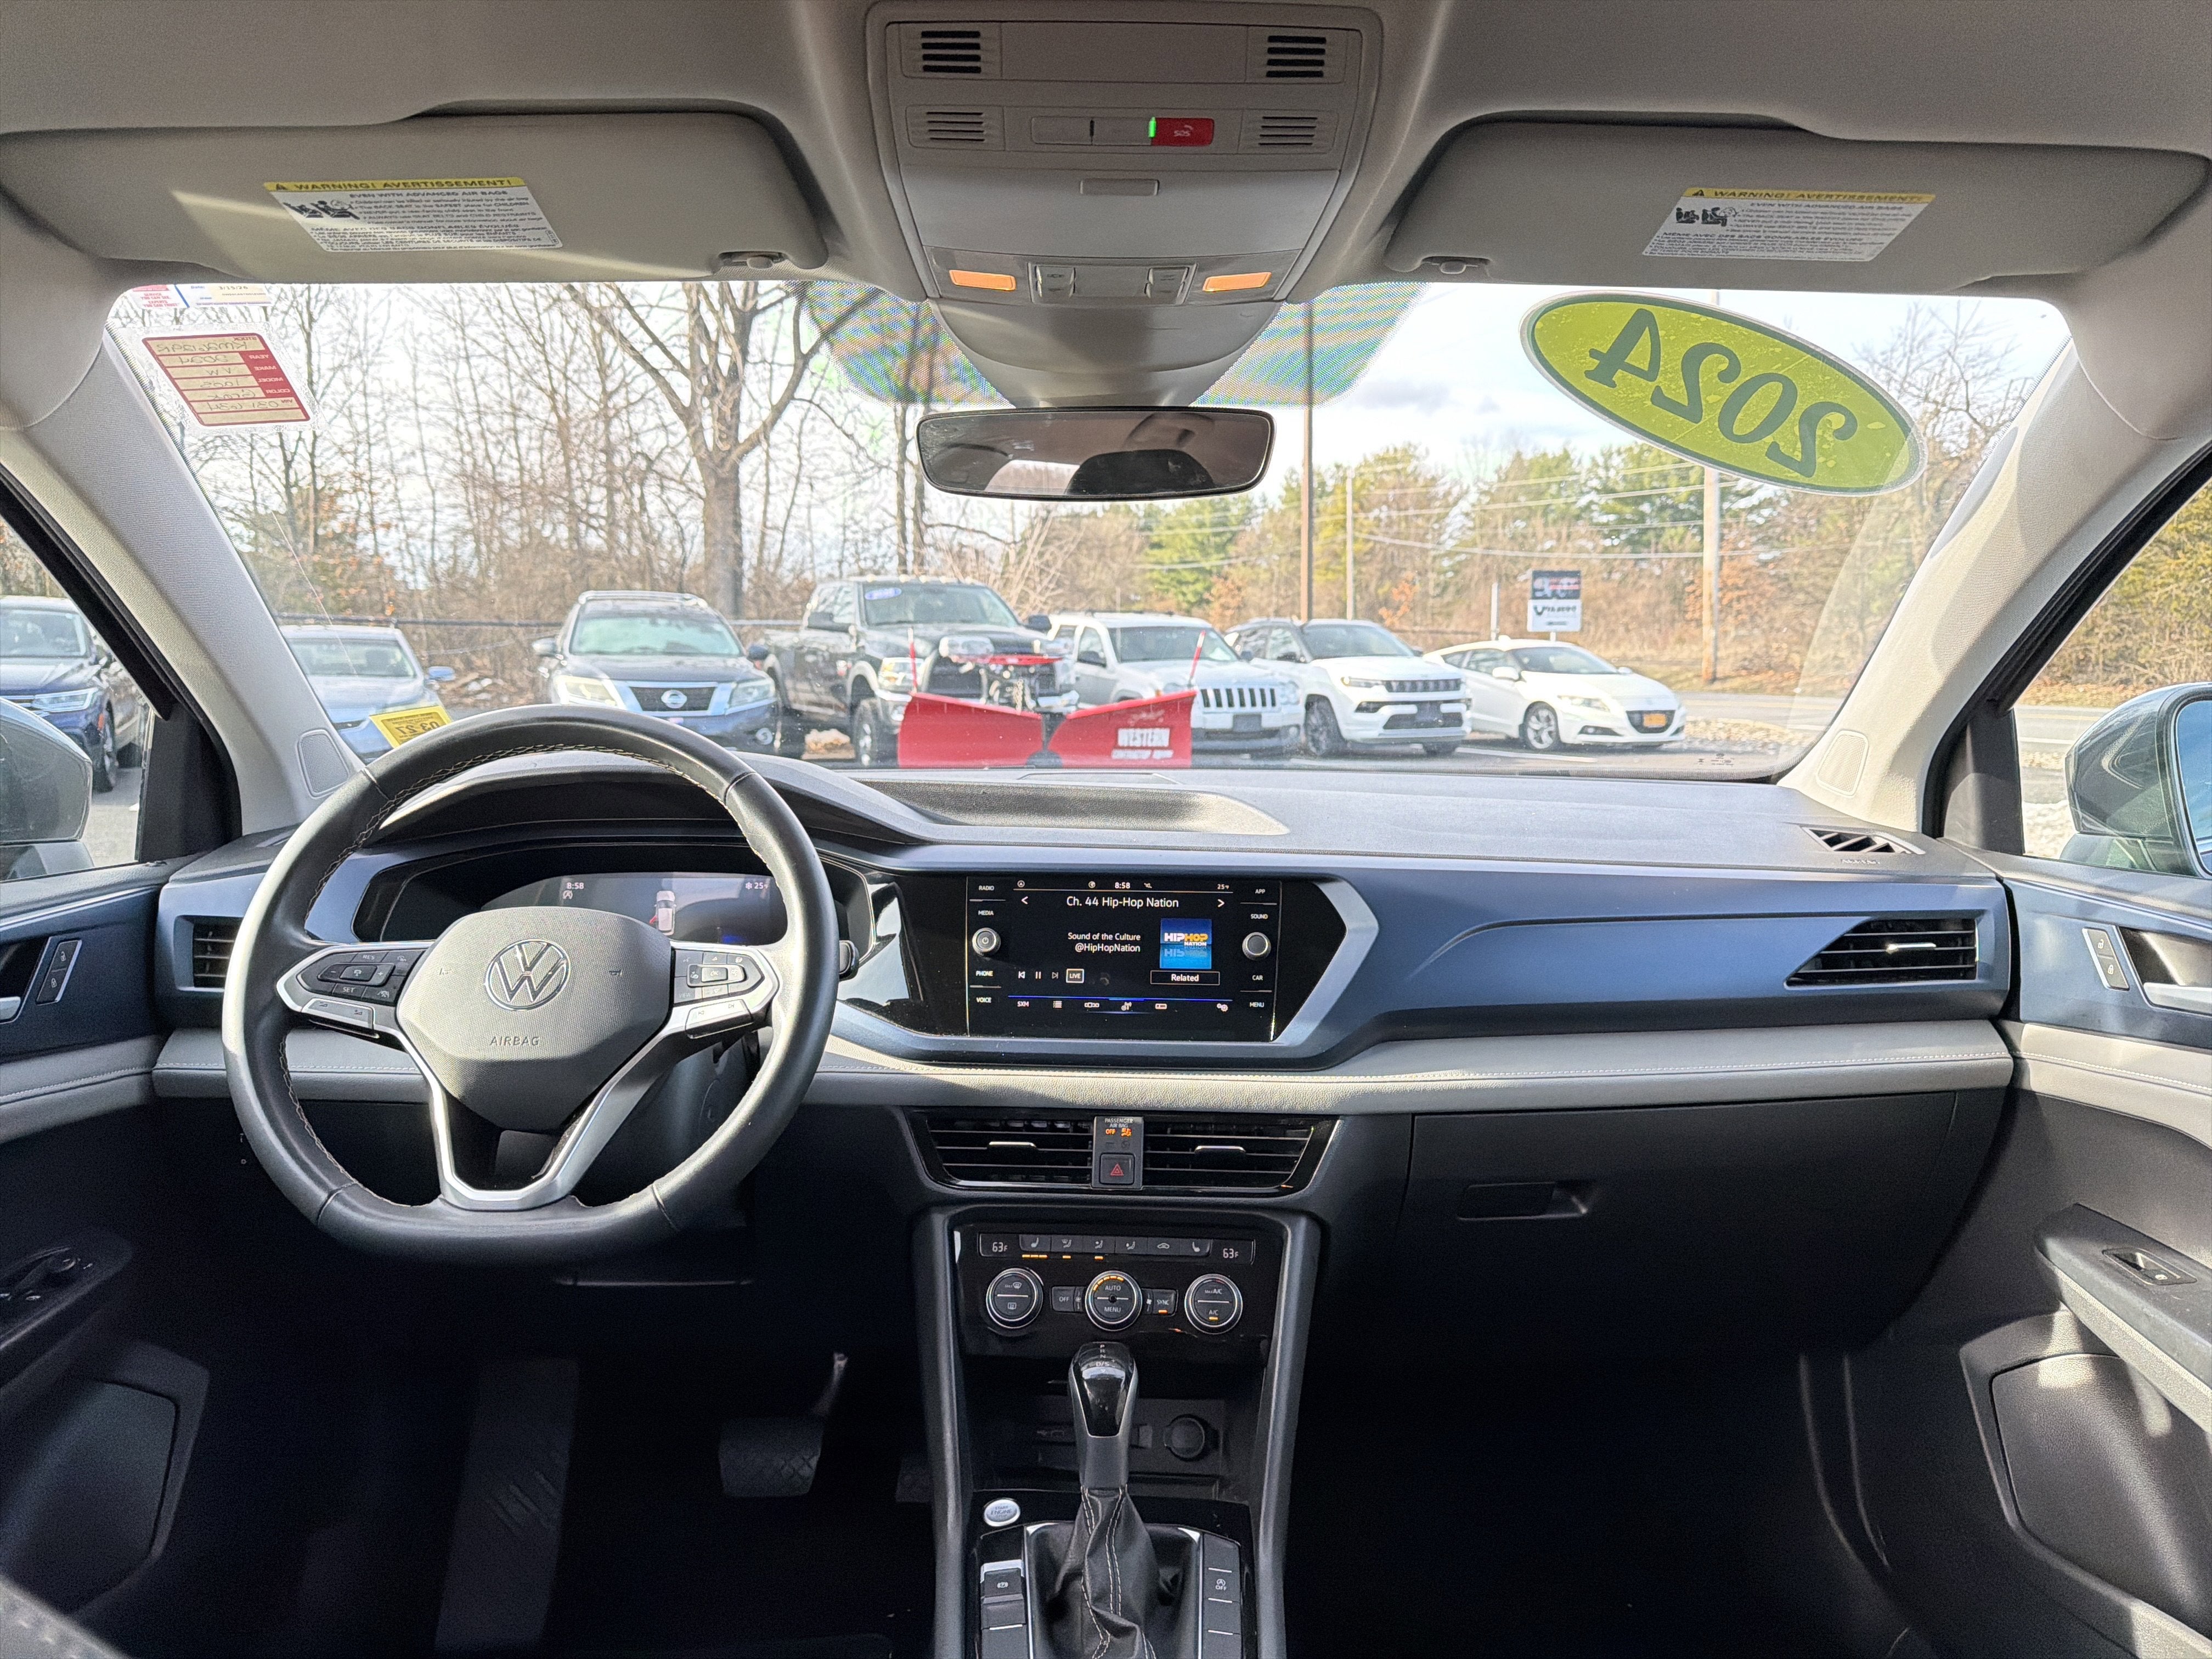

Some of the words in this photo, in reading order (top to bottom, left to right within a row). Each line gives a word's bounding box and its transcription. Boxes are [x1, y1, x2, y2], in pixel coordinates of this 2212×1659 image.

[383, 180, 512, 188] AVERTISSEMENT!
[1066, 896, 1082, 906] Ch.
[1085, 896, 1099, 906] 44
[1102, 896, 1143, 909] Hip-Hop
[1146, 897, 1179, 907] Nation
[1115, 933, 1141, 941] Culture
[1075, 943, 1141, 953] @HipHopNation
[490, 1036, 540, 1046] AIRBAG
